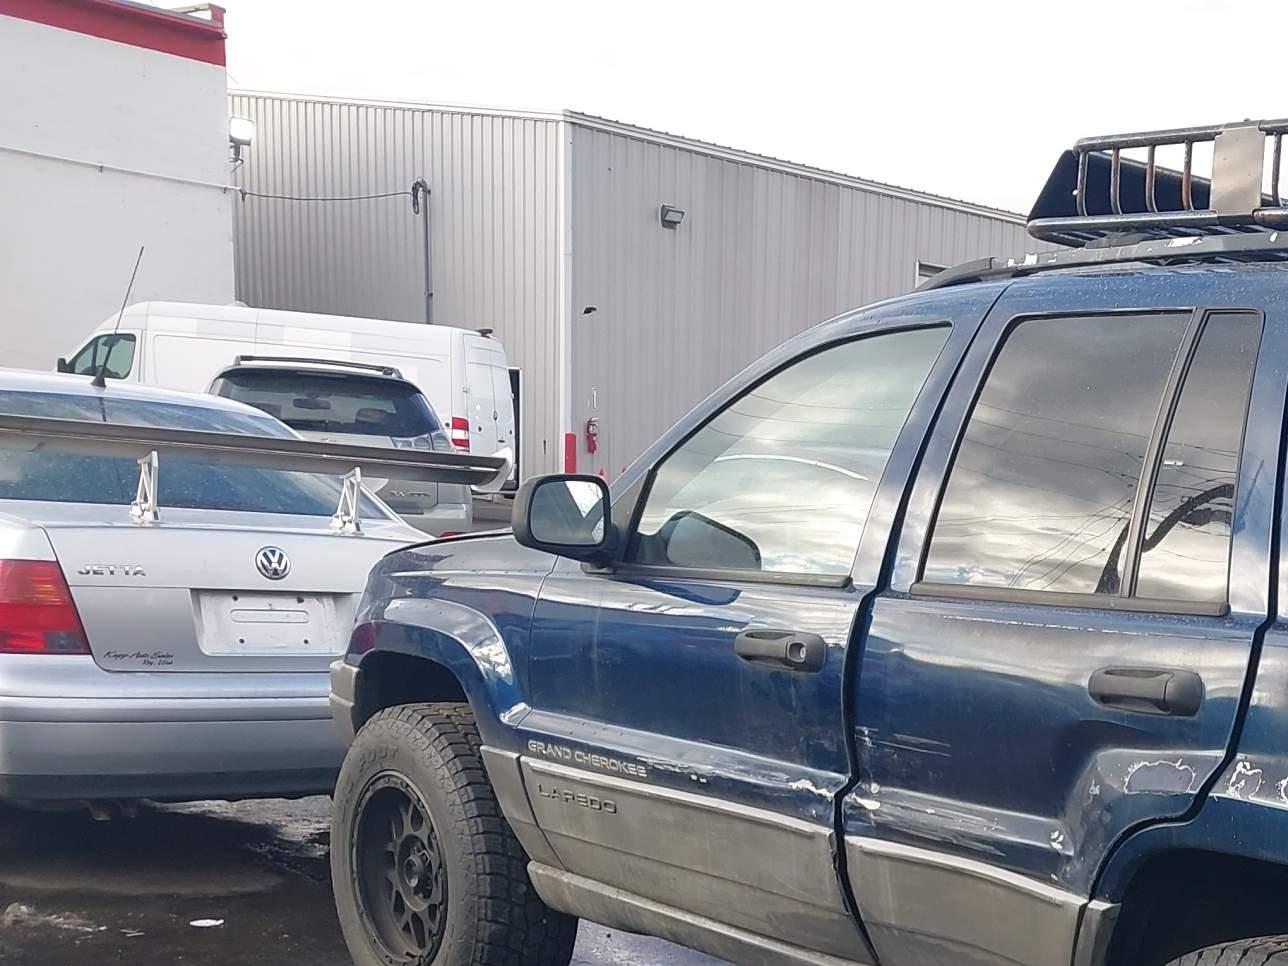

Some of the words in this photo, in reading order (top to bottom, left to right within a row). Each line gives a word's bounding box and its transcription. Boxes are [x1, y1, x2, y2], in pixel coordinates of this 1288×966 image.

[77, 563, 147, 577] JETTA
[528, 739, 572, 760] GRAND
[574, 751, 648, 778] CHEROKEE
[538, 783, 617, 814] LAREDO
